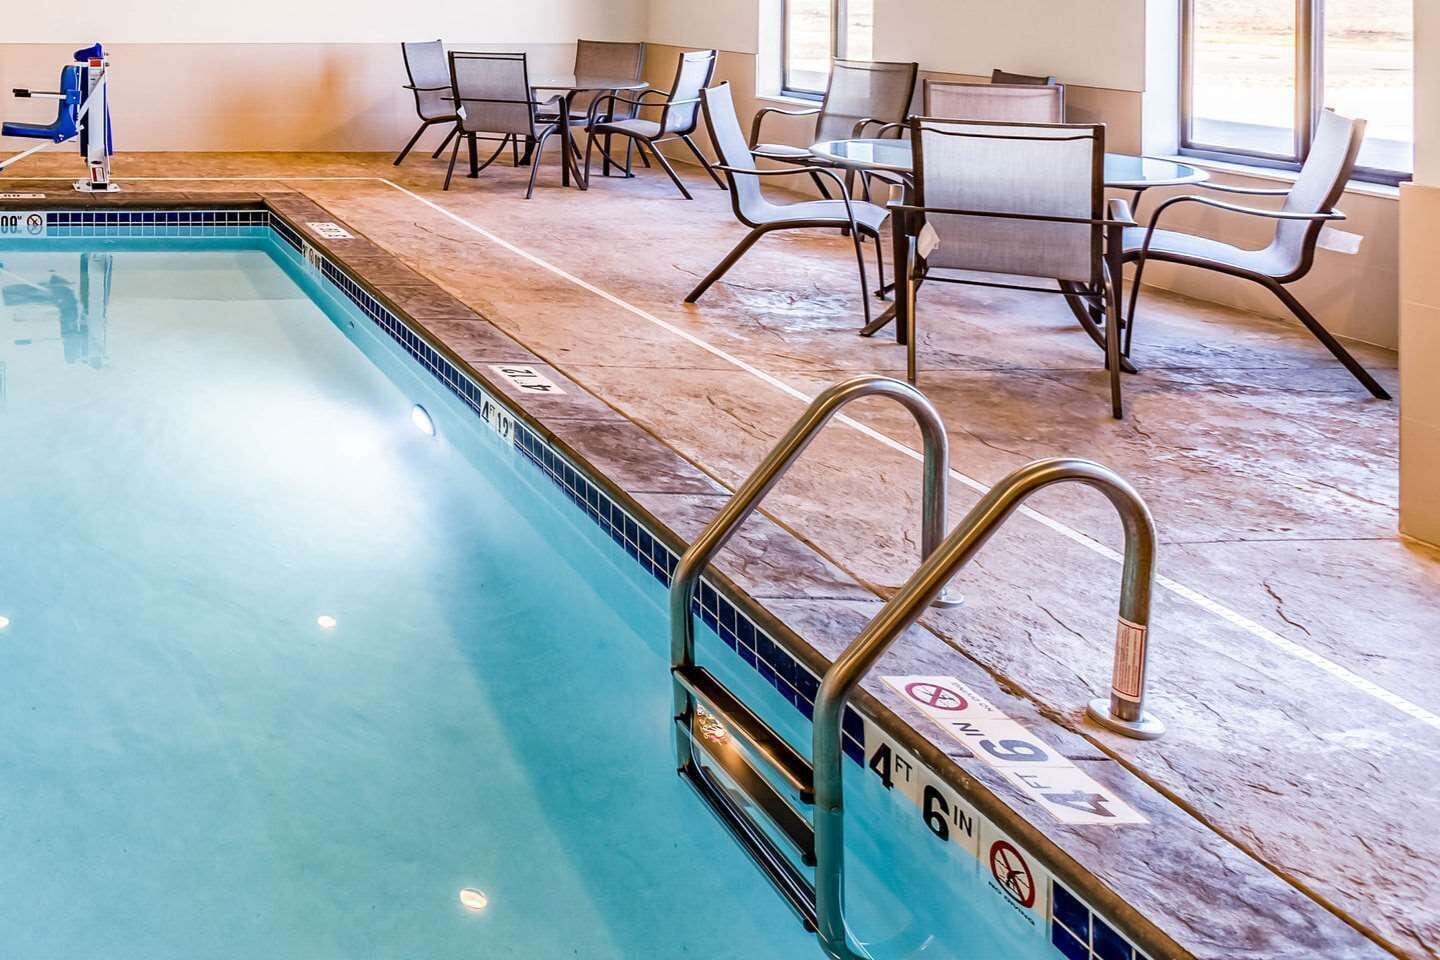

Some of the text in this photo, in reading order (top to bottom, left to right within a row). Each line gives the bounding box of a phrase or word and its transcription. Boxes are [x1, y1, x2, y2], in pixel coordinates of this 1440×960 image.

[481, 400, 490, 423] 4
[869, 742, 973, 841] 4 FT 6 IN
[952, 721, 1117, 818] 4 FT 6 IN
